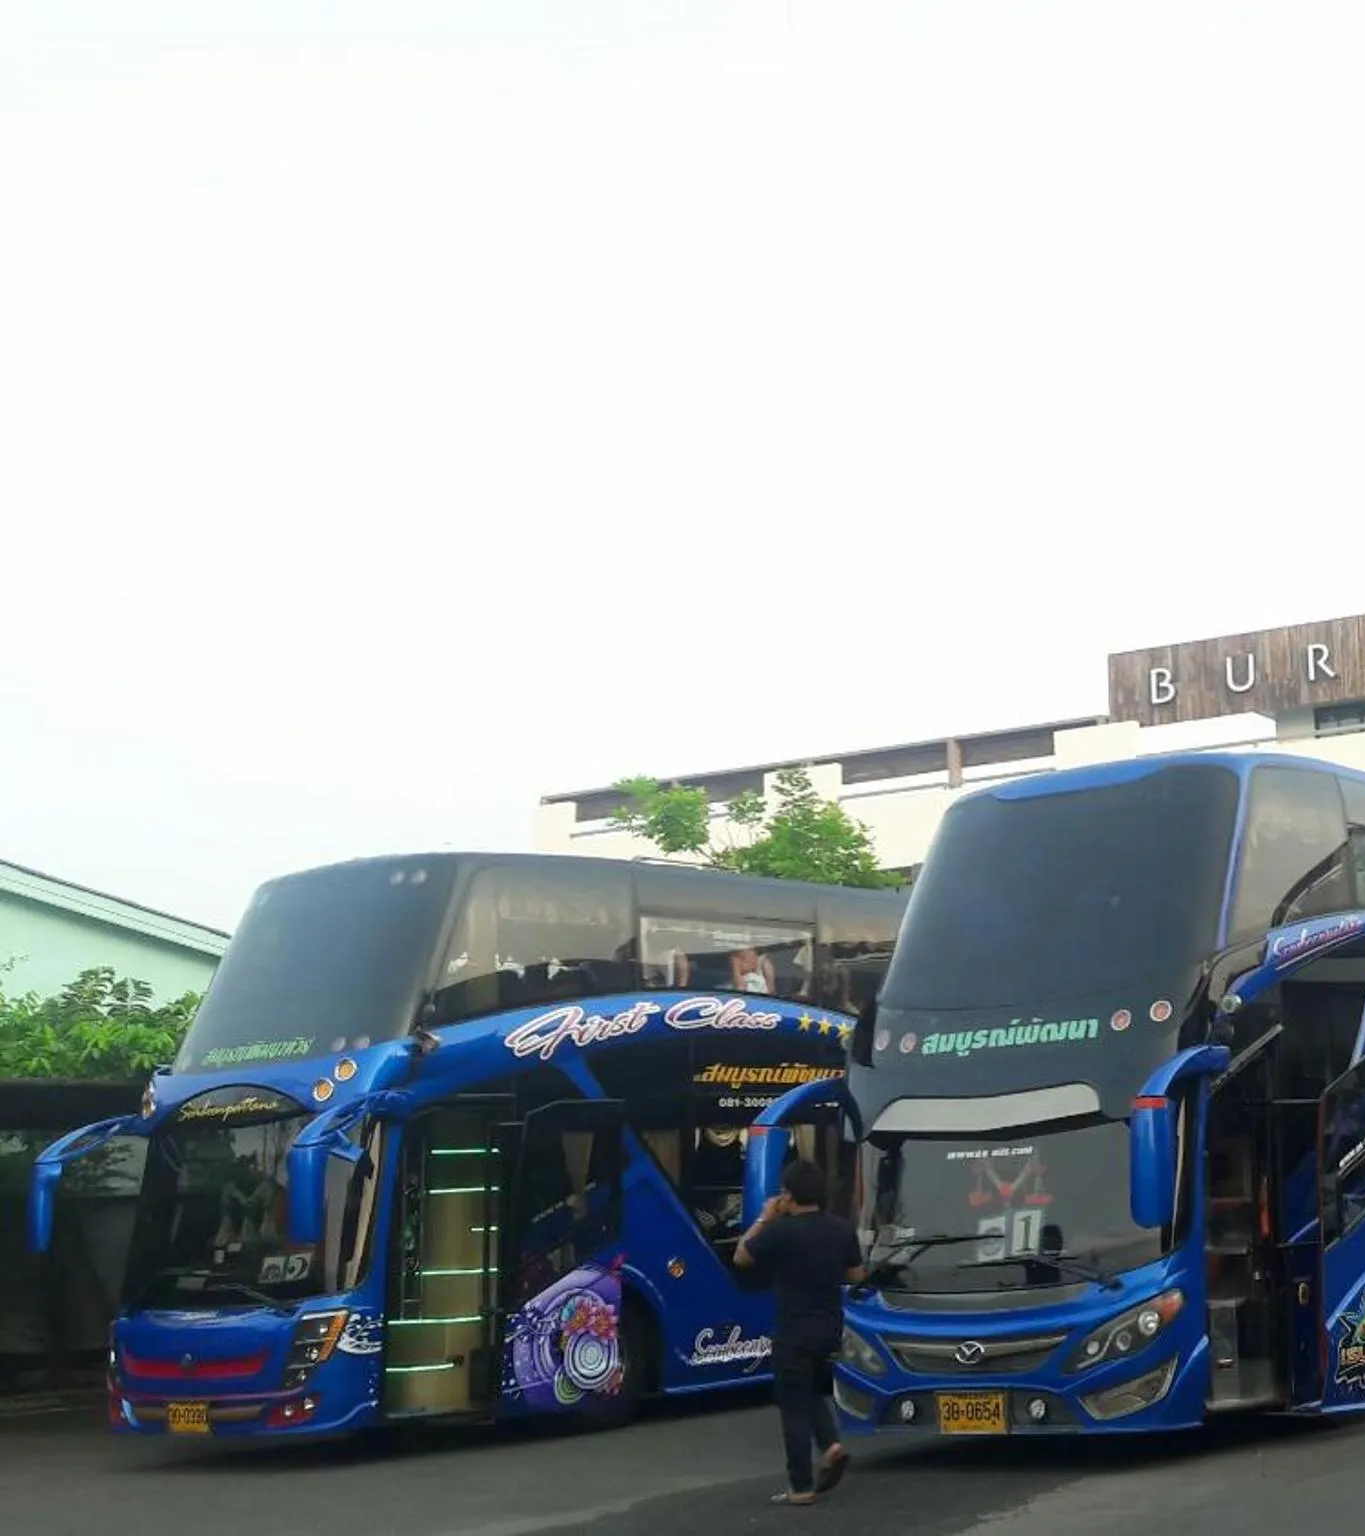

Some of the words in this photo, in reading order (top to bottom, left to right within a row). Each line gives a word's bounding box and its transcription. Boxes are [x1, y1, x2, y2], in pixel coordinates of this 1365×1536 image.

[504, 1001, 660, 1060] First
[665, 996, 781, 1030] Class
[922, 1016, 1099, 1057] สมบูรณ์พัฒนา
